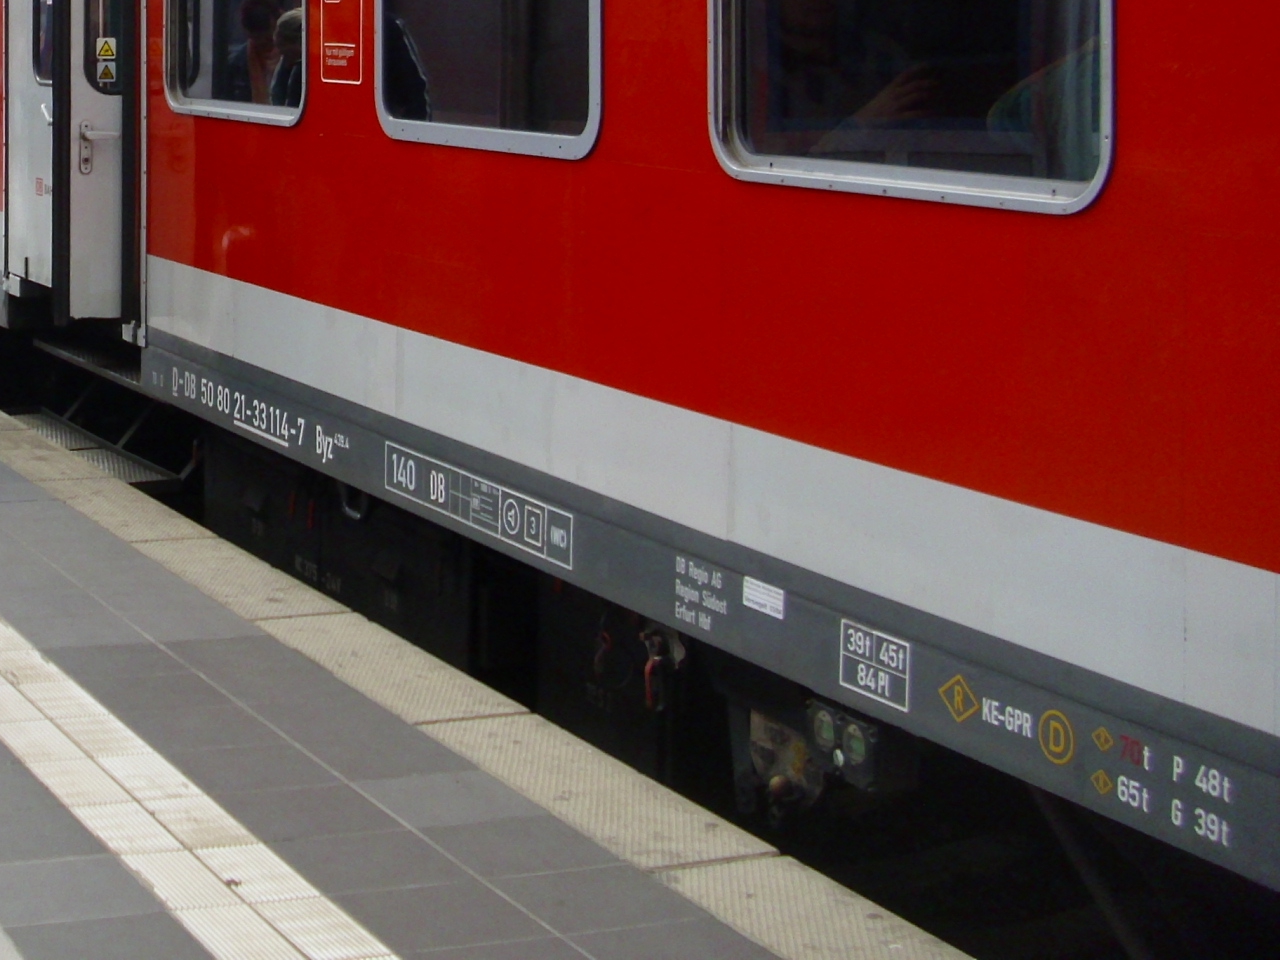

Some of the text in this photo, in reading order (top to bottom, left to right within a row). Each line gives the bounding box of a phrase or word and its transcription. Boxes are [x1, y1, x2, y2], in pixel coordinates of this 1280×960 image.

[201, 378, 214, 407] 50
[217, 385, 230, 414] 80
[392, 453, 416, 491] 140
[430, 470, 445, 504] DB
[529, 516, 537, 535] 3
[675, 556, 722, 589] DB Regio AG
[675, 578, 699, 603] Region
[675, 601, 695, 625] Erfurt
[857, 663, 876, 690] 84
[953, 685, 964, 712] R
[982, 697, 1032, 738] KE-GPR
[1049, 720, 1065, 753] D
[1173, 755, 1183, 782] P
[1194, 765, 1231, 804] 48t
[1117, 775, 1149, 813] 65t
[1172, 799, 1183, 826] G
[1194, 808, 1230, 846] 39t
